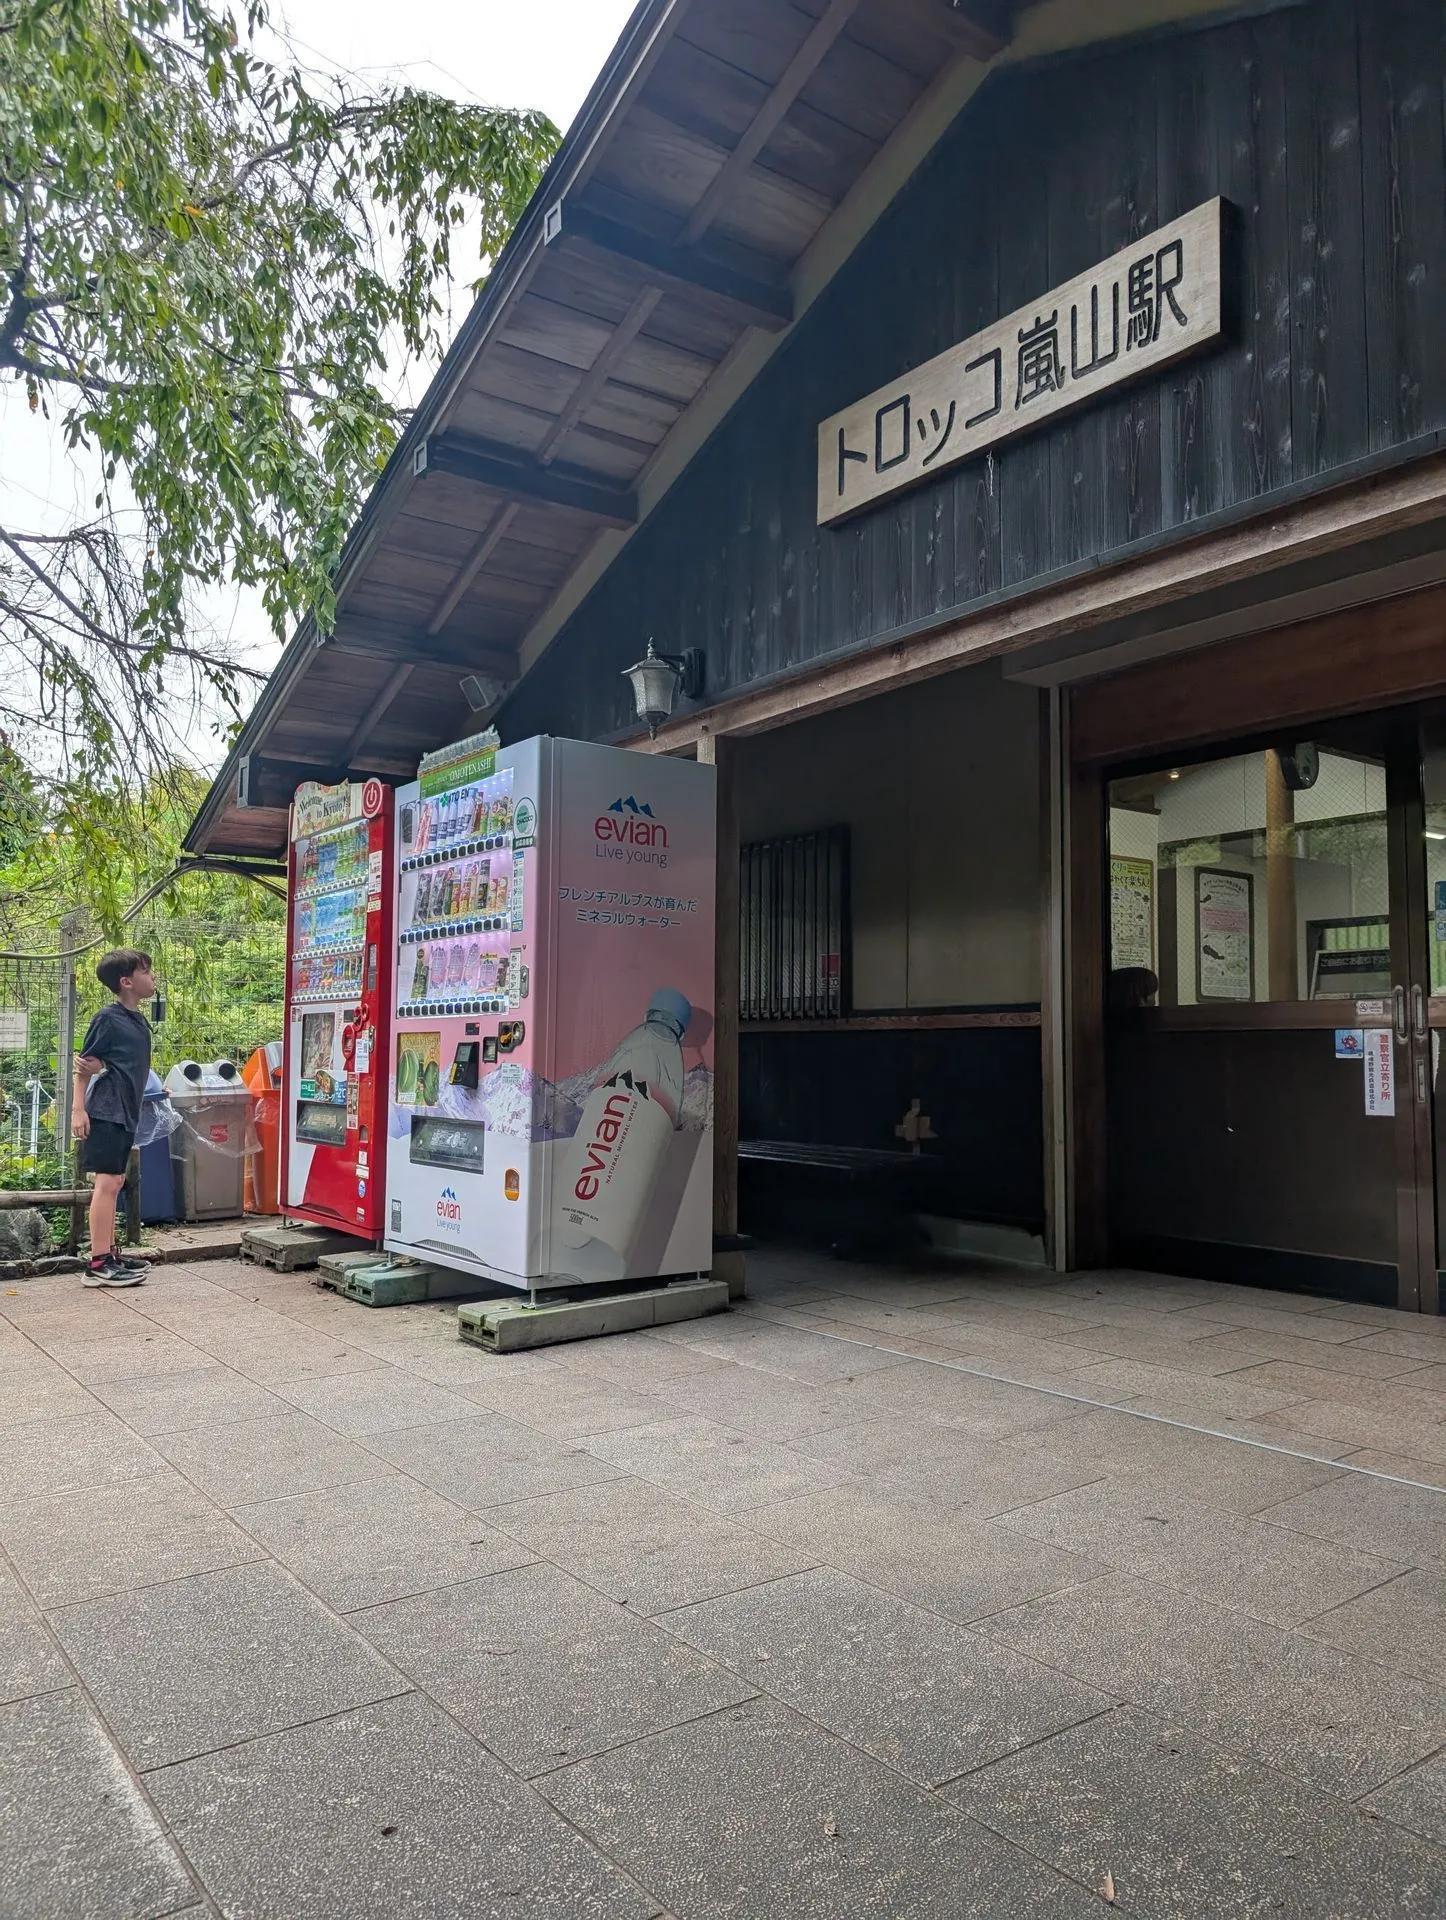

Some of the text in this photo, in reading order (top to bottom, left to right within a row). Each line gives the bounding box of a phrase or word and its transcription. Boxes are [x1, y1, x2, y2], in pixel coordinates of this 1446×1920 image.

[838, 238, 1188, 496] トロッコ嵐山駅
[449, 756, 493, 781] OMOTENASHI
[461, 787, 470, 800] EN
[595, 815, 669, 848] evian
[595, 844, 668, 868] Live young
[558, 887, 698, 912] フレンチアルプスが育んだ
[576, 909, 681, 929] ミネラルウォーター
[1379, 1034, 1391, 1101] 警察官立寄り所
[574, 1093, 632, 1200] evian
[605, 1100, 638, 1184] NATURAL MINERAL WATER
[436, 1199, 461, 1221] evian
[436, 1218, 461, 1234] Live young
